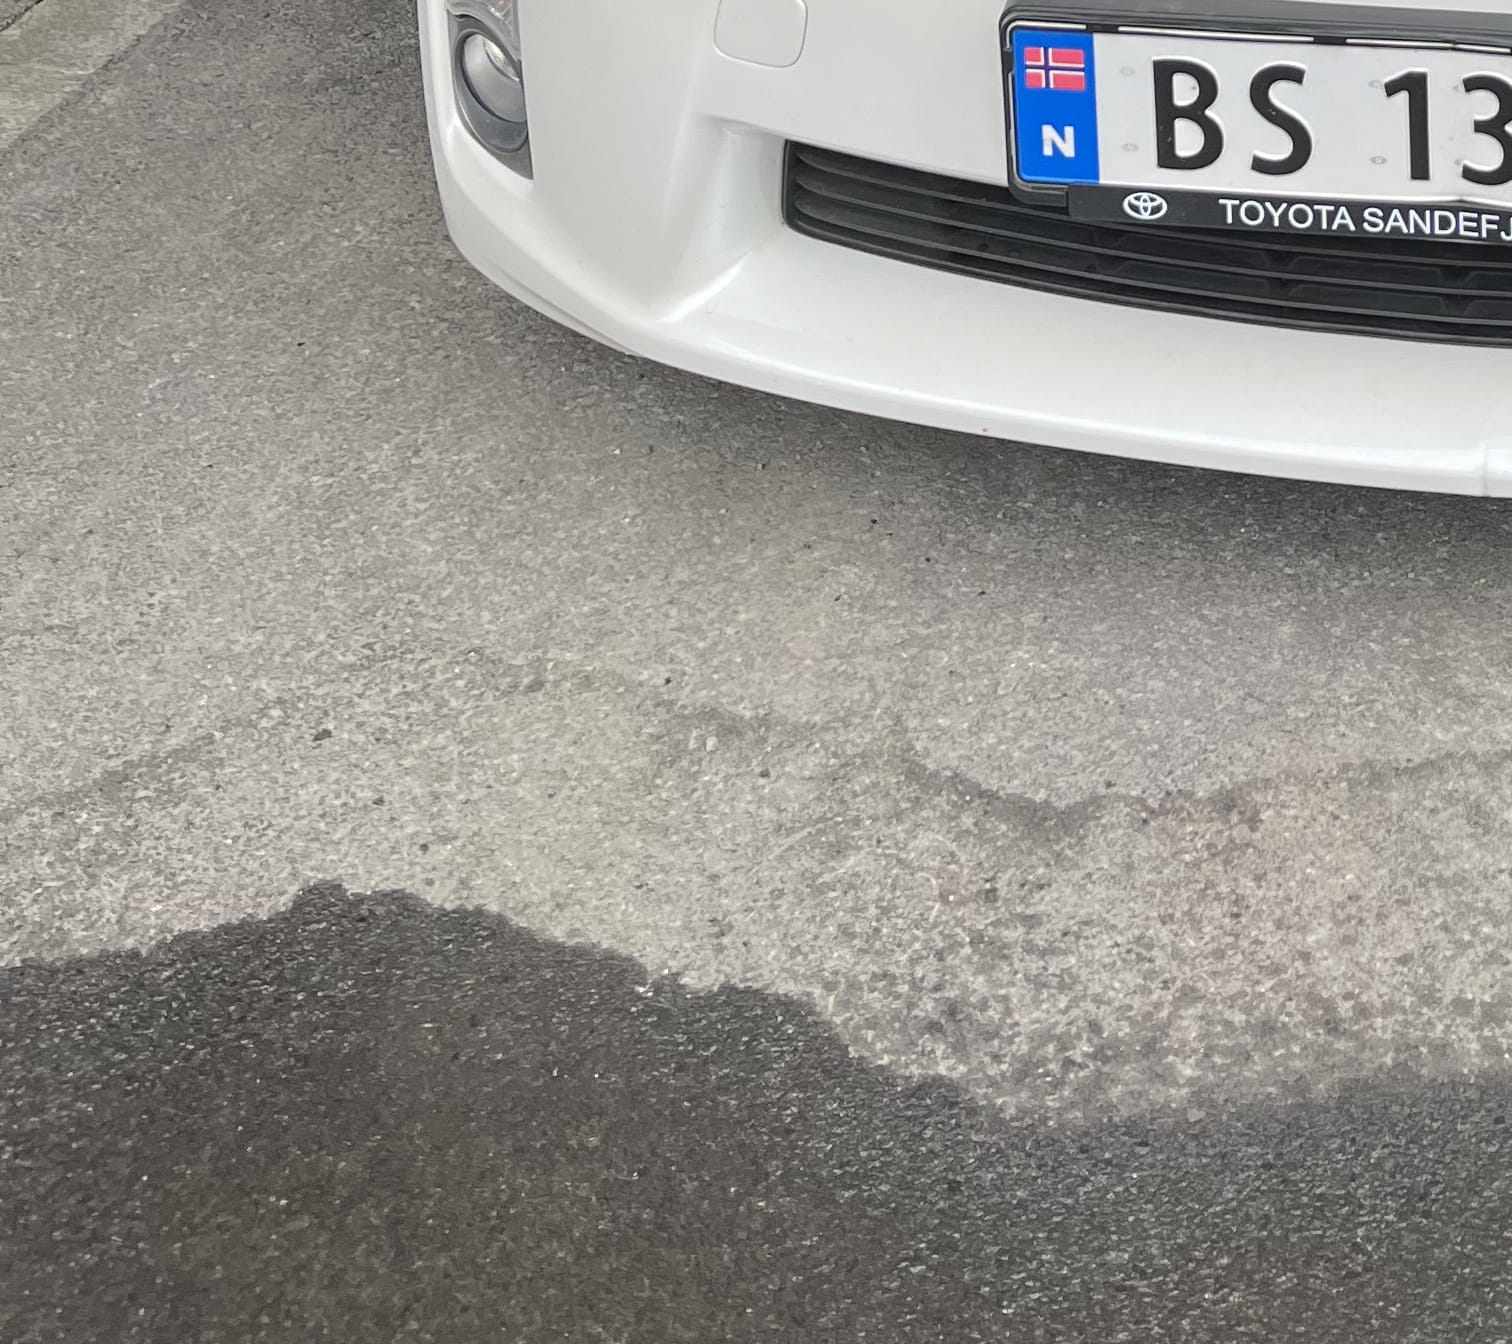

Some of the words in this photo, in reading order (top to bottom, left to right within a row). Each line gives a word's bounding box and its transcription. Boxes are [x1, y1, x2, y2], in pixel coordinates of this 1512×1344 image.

[1153, 60, 1311, 175] BS
[1042, 125, 1075, 157] N
[1219, 199, 1355, 231] TOYOTA
